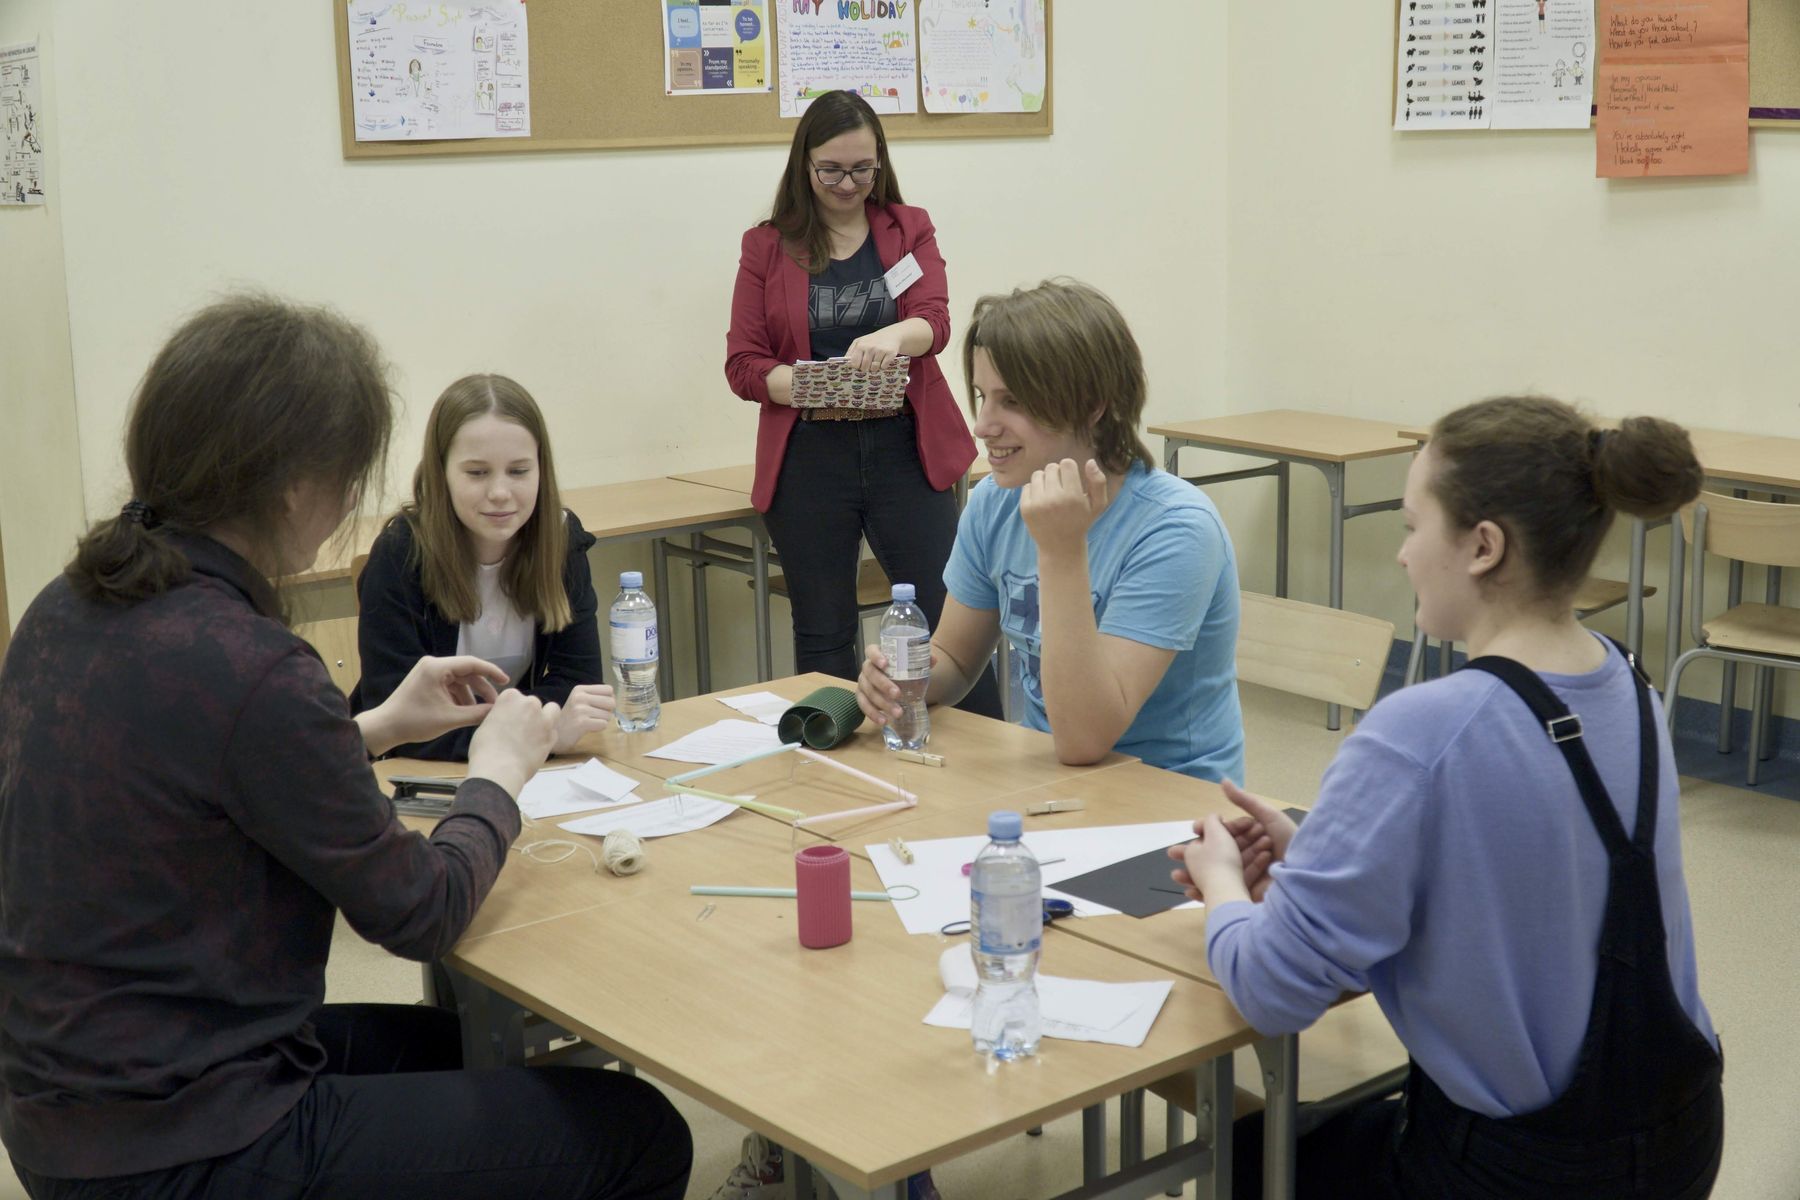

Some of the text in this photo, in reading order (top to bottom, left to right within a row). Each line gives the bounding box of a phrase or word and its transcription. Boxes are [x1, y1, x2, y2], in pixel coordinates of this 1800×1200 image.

[792, 0, 907, 21] MY HOLIDAY
[1610, 14, 1628, 27] What
[1631, 16, 1640, 25] do
[1641, 16, 1654, 27] you
[1638, 26, 1649, 39] you
[1670, 22, 1689, 33] about
[1624, 38, 1632, 48] do
[1634, 39, 1644, 49] you
[1620, 75, 1631, 86] my
[1635, 130, 1669, 143] absolutely
